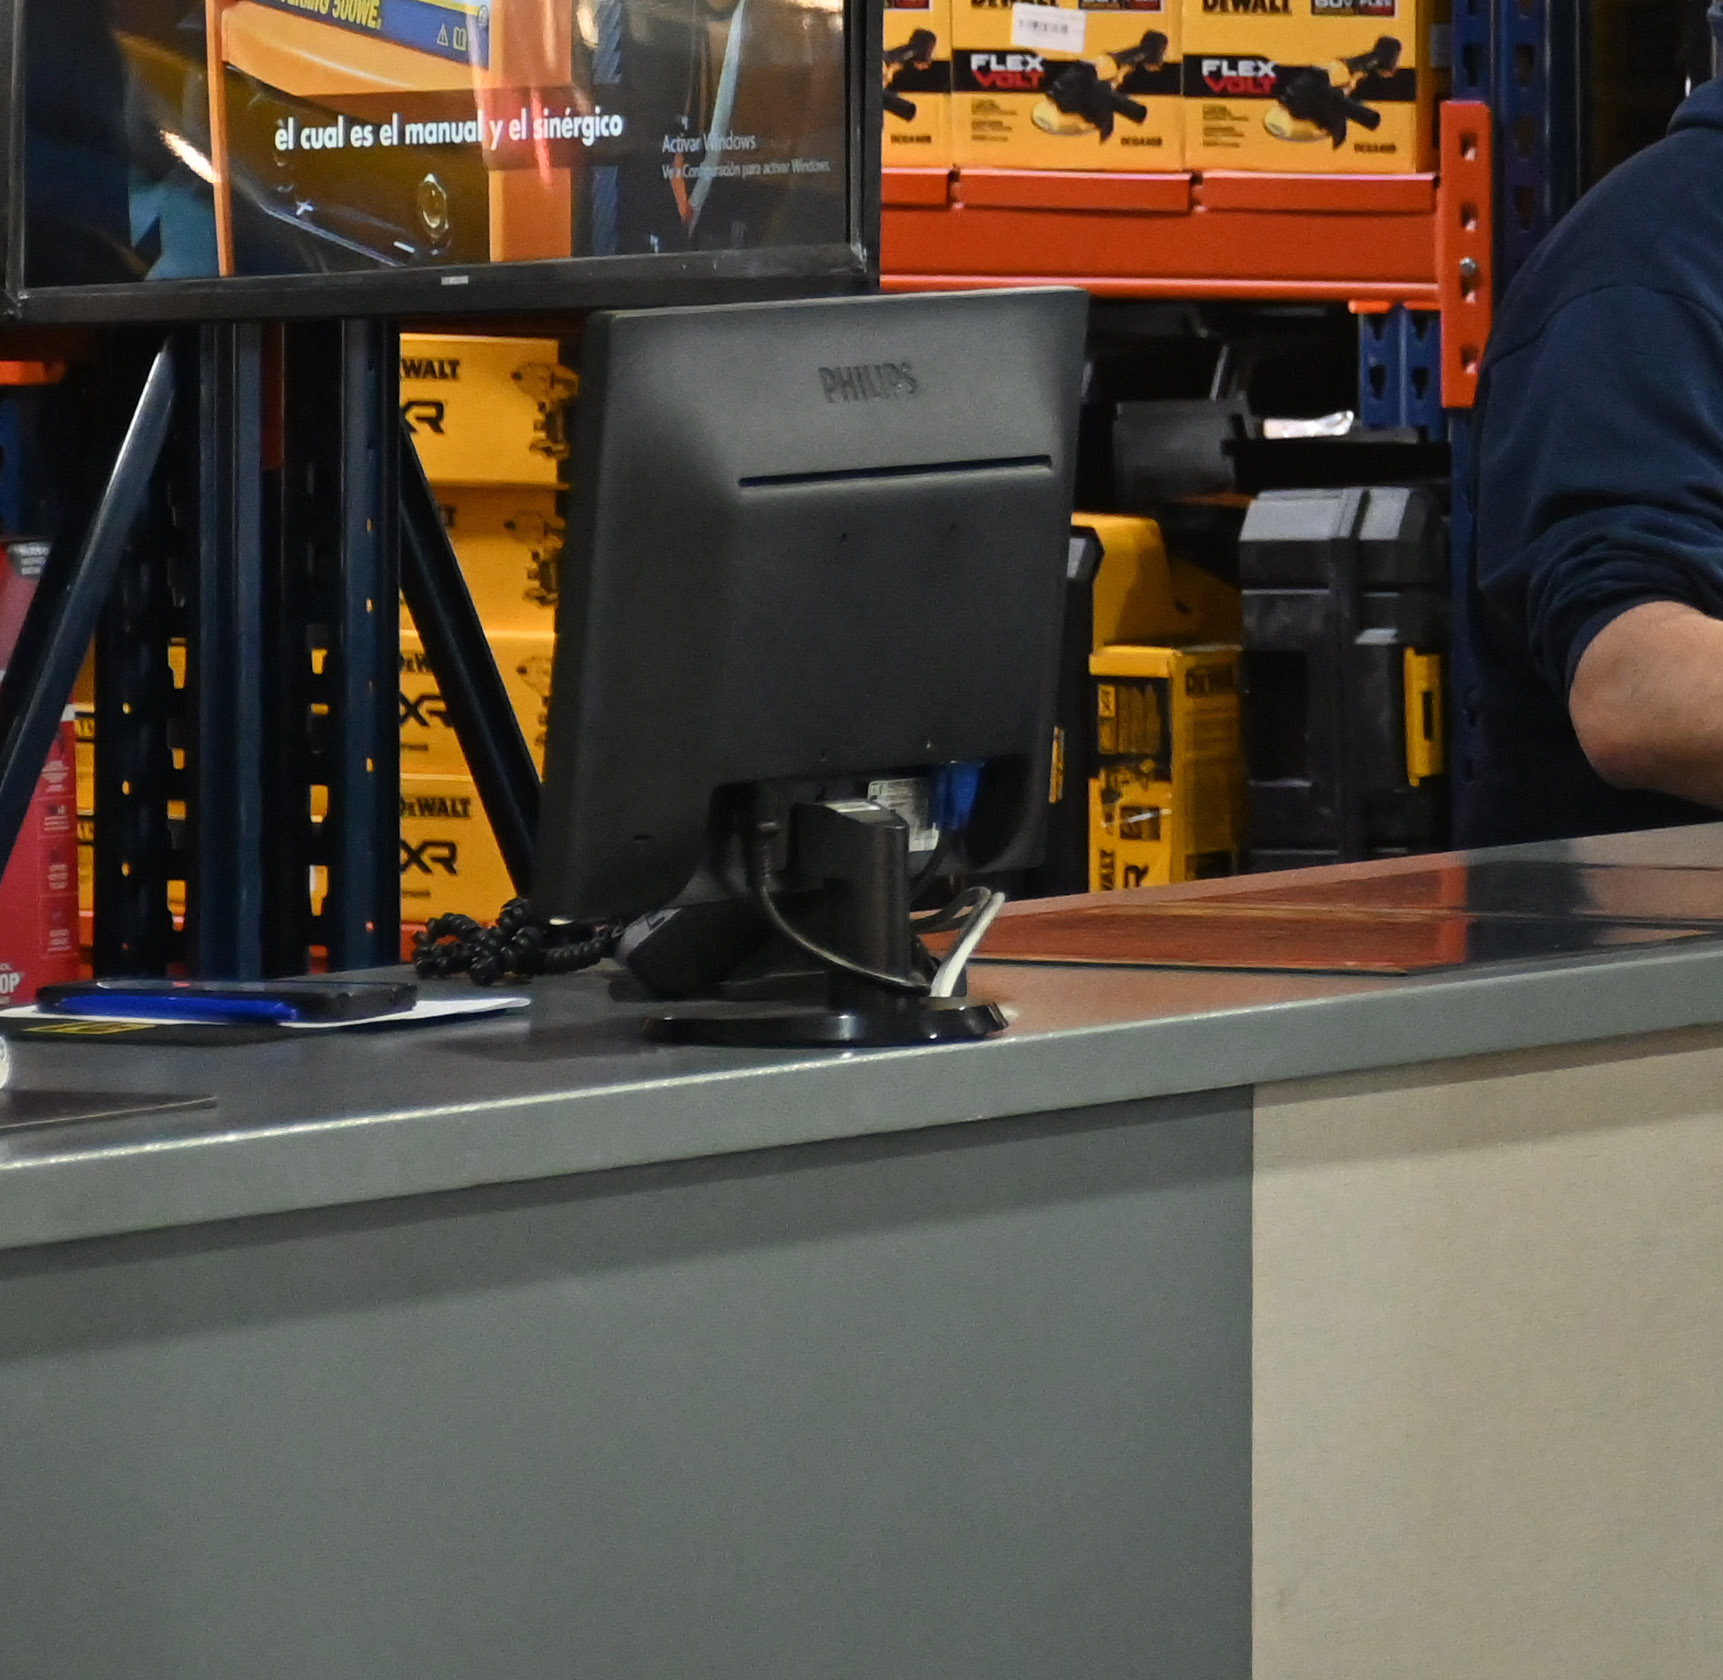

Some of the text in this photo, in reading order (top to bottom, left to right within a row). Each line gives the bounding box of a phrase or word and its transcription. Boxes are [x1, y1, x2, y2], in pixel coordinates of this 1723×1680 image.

[971, 52, 1046, 71] FLEX
[1202, 58, 1277, 77] FLEX
[973, 69, 1047, 88] VOLT
[1204, 74, 1278, 94] VOLT
[300, 116, 343, 149] cual
[350, 125, 373, 148] es
[379, 113, 399, 146] el
[405, 110, 483, 145] manual
[491, 118, 504, 150] y
[509, 108, 528, 141] el
[533, 106, 623, 146] sinérgico
[818, 362, 918, 403] PHILIPS
